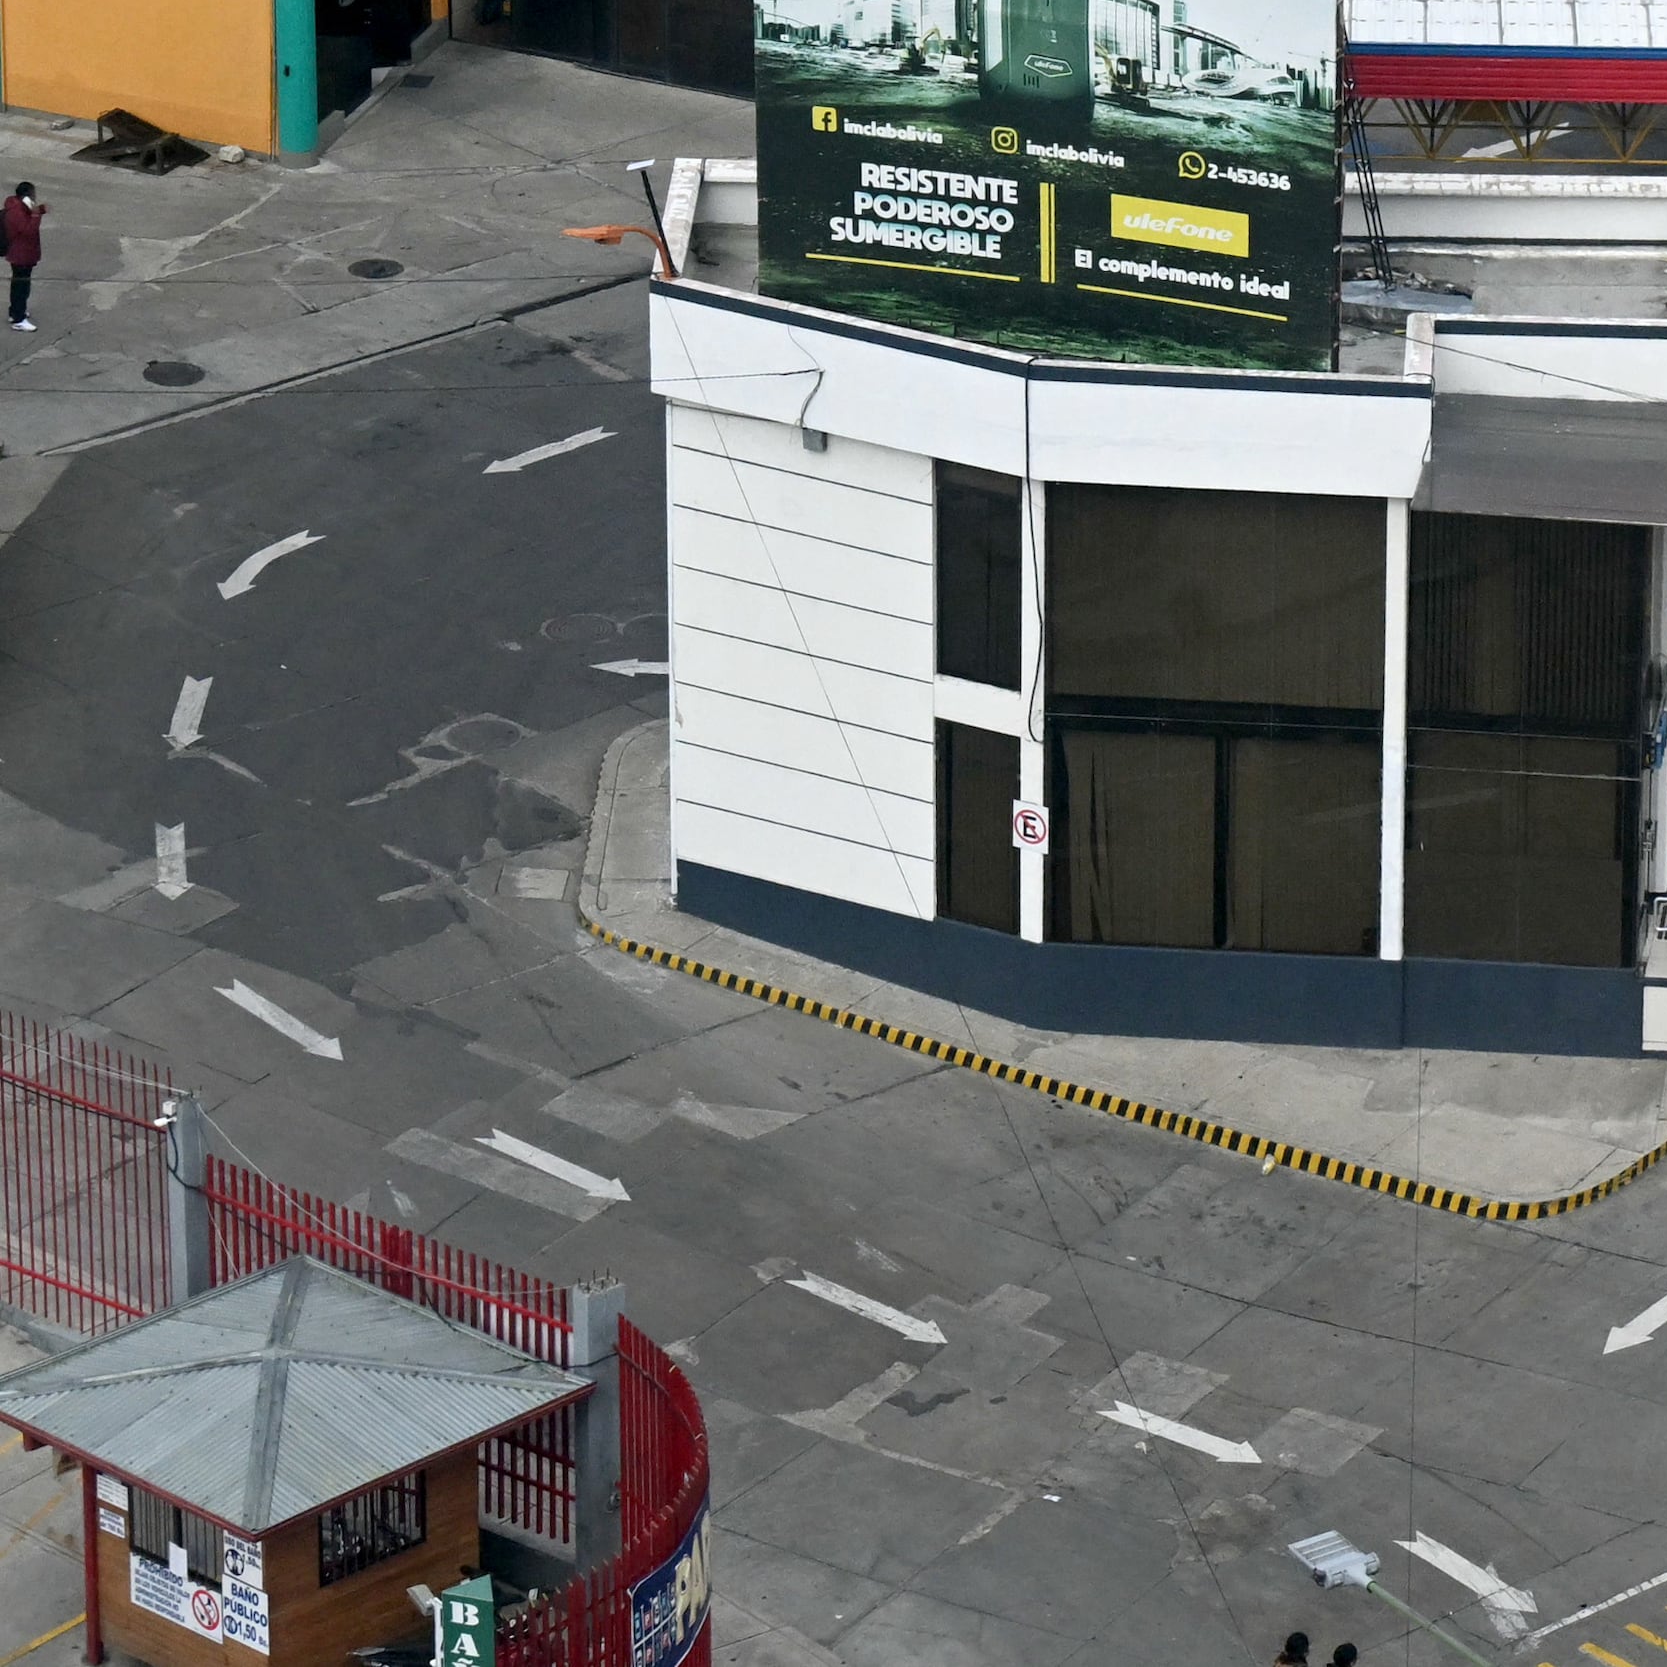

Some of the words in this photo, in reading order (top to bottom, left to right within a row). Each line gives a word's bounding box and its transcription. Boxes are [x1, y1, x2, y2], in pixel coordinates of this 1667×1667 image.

[844, 118, 943, 144] imclabolivia
[1026, 140, 1125, 168] imclabolivia
[861, 162, 1018, 204] RESISTENTE
[1207, 163, 1291, 191] 2-453636
[854, 191, 1014, 232] PODEROSO
[829, 217, 1001, 259] SUMERGIBLE
[1074, 248, 1092, 269] El
[1098, 257, 1234, 291] complemento
[1240, 274, 1290, 300] ideal
[1023, 815, 1036, 839] E
[139, 1558, 183, 1587] PROHIBIDO
[231, 1583, 259, 1606] BAÑO
[224, 1596, 268, 1627] PÚBLICO
[237, 1622, 256, 1641] 1,50
